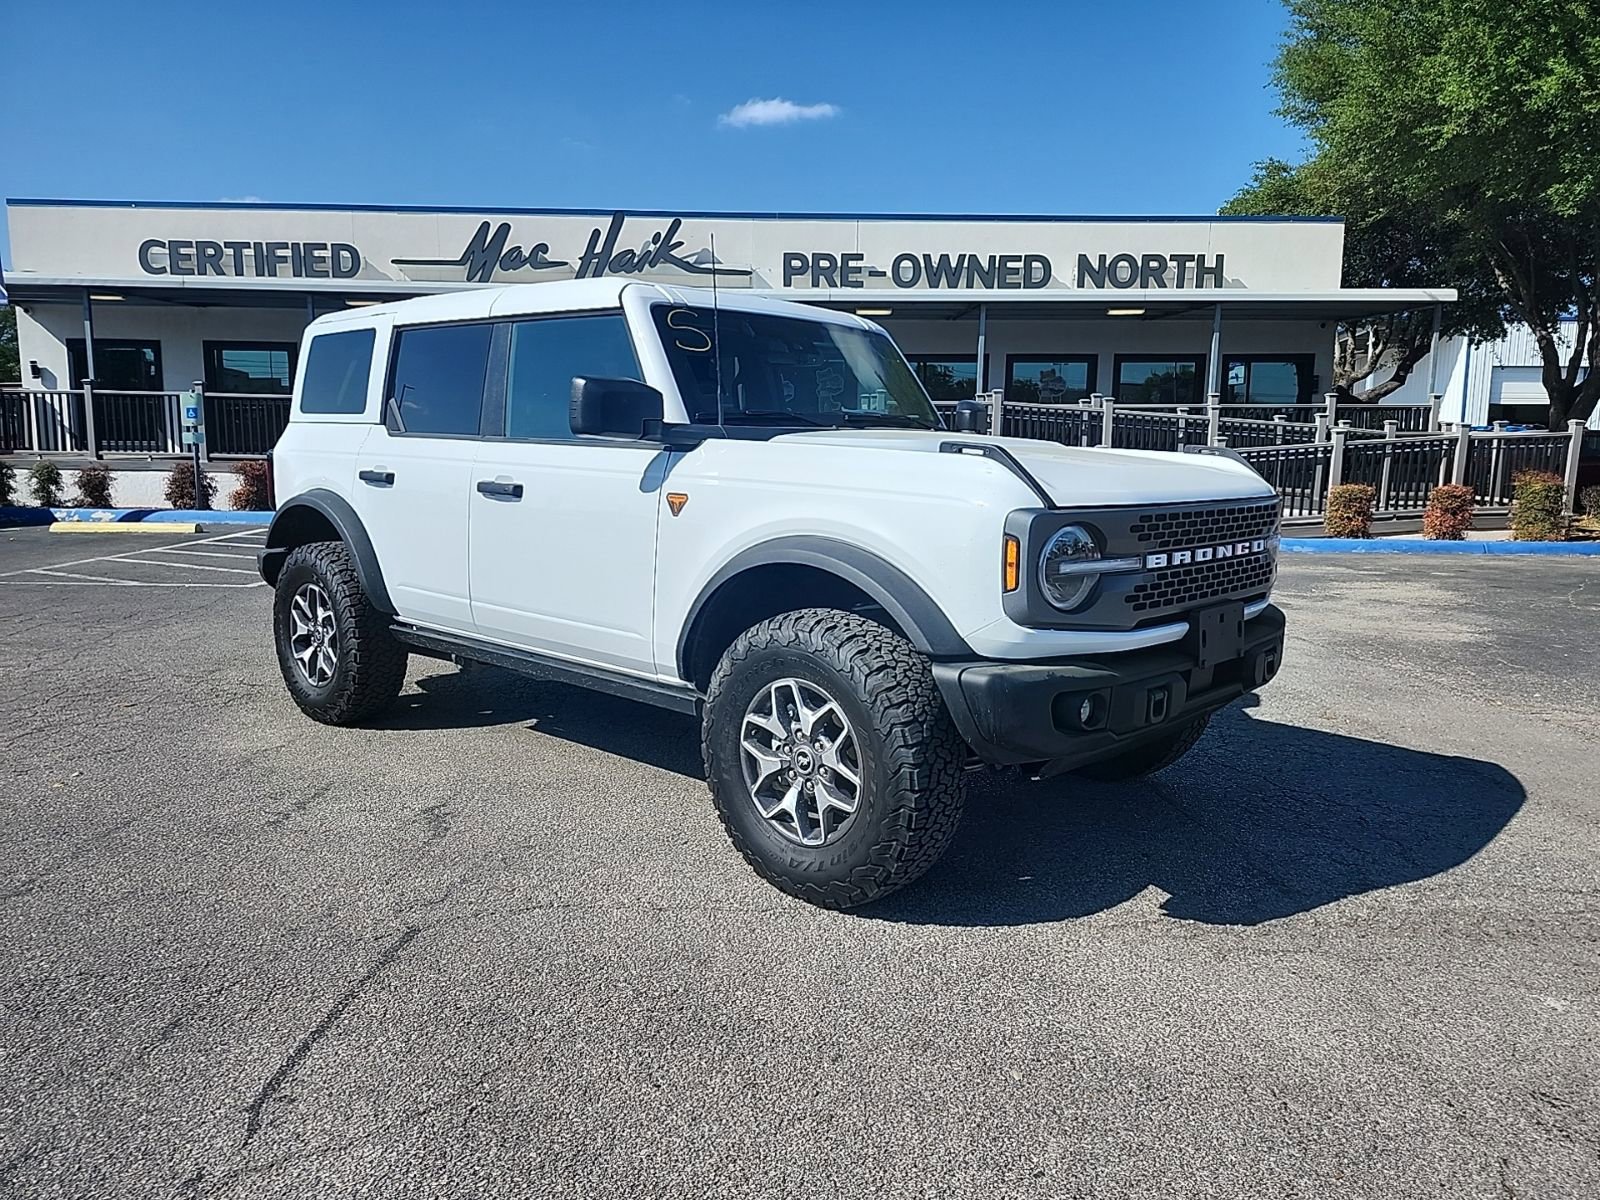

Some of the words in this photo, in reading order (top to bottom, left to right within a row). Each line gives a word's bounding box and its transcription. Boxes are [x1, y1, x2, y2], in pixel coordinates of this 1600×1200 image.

[138, 239, 361, 278] CERTIFIED
[391, 221, 568, 282] Mac
[574, 211, 752, 279] Haik
[783, 253, 1051, 289] PRE-OWNED
[1077, 253, 1224, 288] NORTH
[1146, 540, 1264, 568] BRONCO
